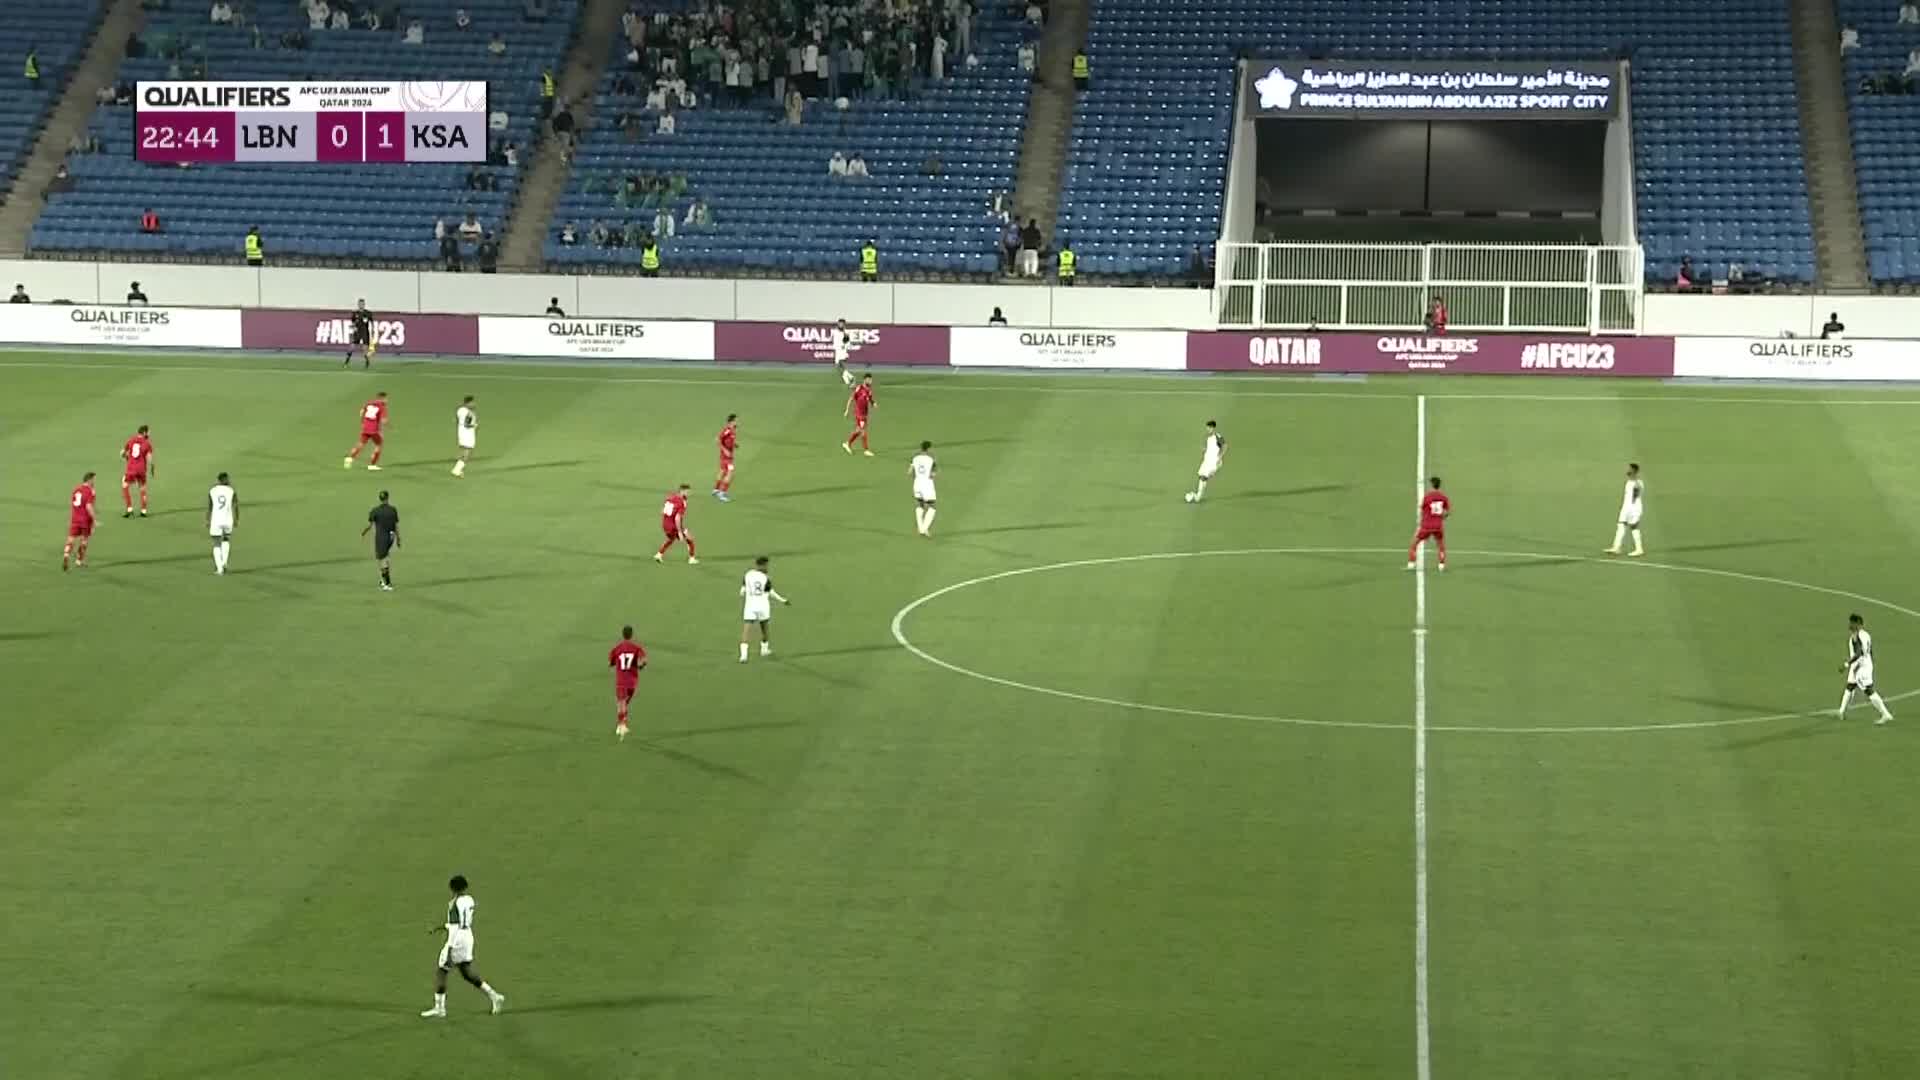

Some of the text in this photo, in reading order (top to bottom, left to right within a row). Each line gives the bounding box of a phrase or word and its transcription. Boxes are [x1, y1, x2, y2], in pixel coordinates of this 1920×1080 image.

[1411, 74, 1440, 90] عبد
[1440, 71, 1461, 90] بن
[1462, 72, 1519, 89] سلطان
[1520, 69, 1563, 90] الأمير
[1564, 70, 1610, 90] مدينة
[1300, 93, 1353, 107] PRINCE
[1353, 94, 1408, 108] SULTAN
[1432, 94, 1517, 108] ABDULAZIZ
[1519, 94, 1570, 109] SPORT
[1572, 95, 1609, 108] CITY
[70, 308, 171, 325] QUALIFIERS
[315, 318, 406, 346] #AFU23
[547, 321, 645, 338] QUALIFIERS
[1019, 332, 1117, 347] QUALIFIERS
[1376, 336, 1479, 353] QUALIFIERS
[1249, 337, 1321, 366] QATAR
[1520, 342, 1615, 370] #AFCU23
[1749, 342, 1854, 358] QUALIFIERS
[217, 495, 227, 511] 9
[618, 652, 635, 671] 17
